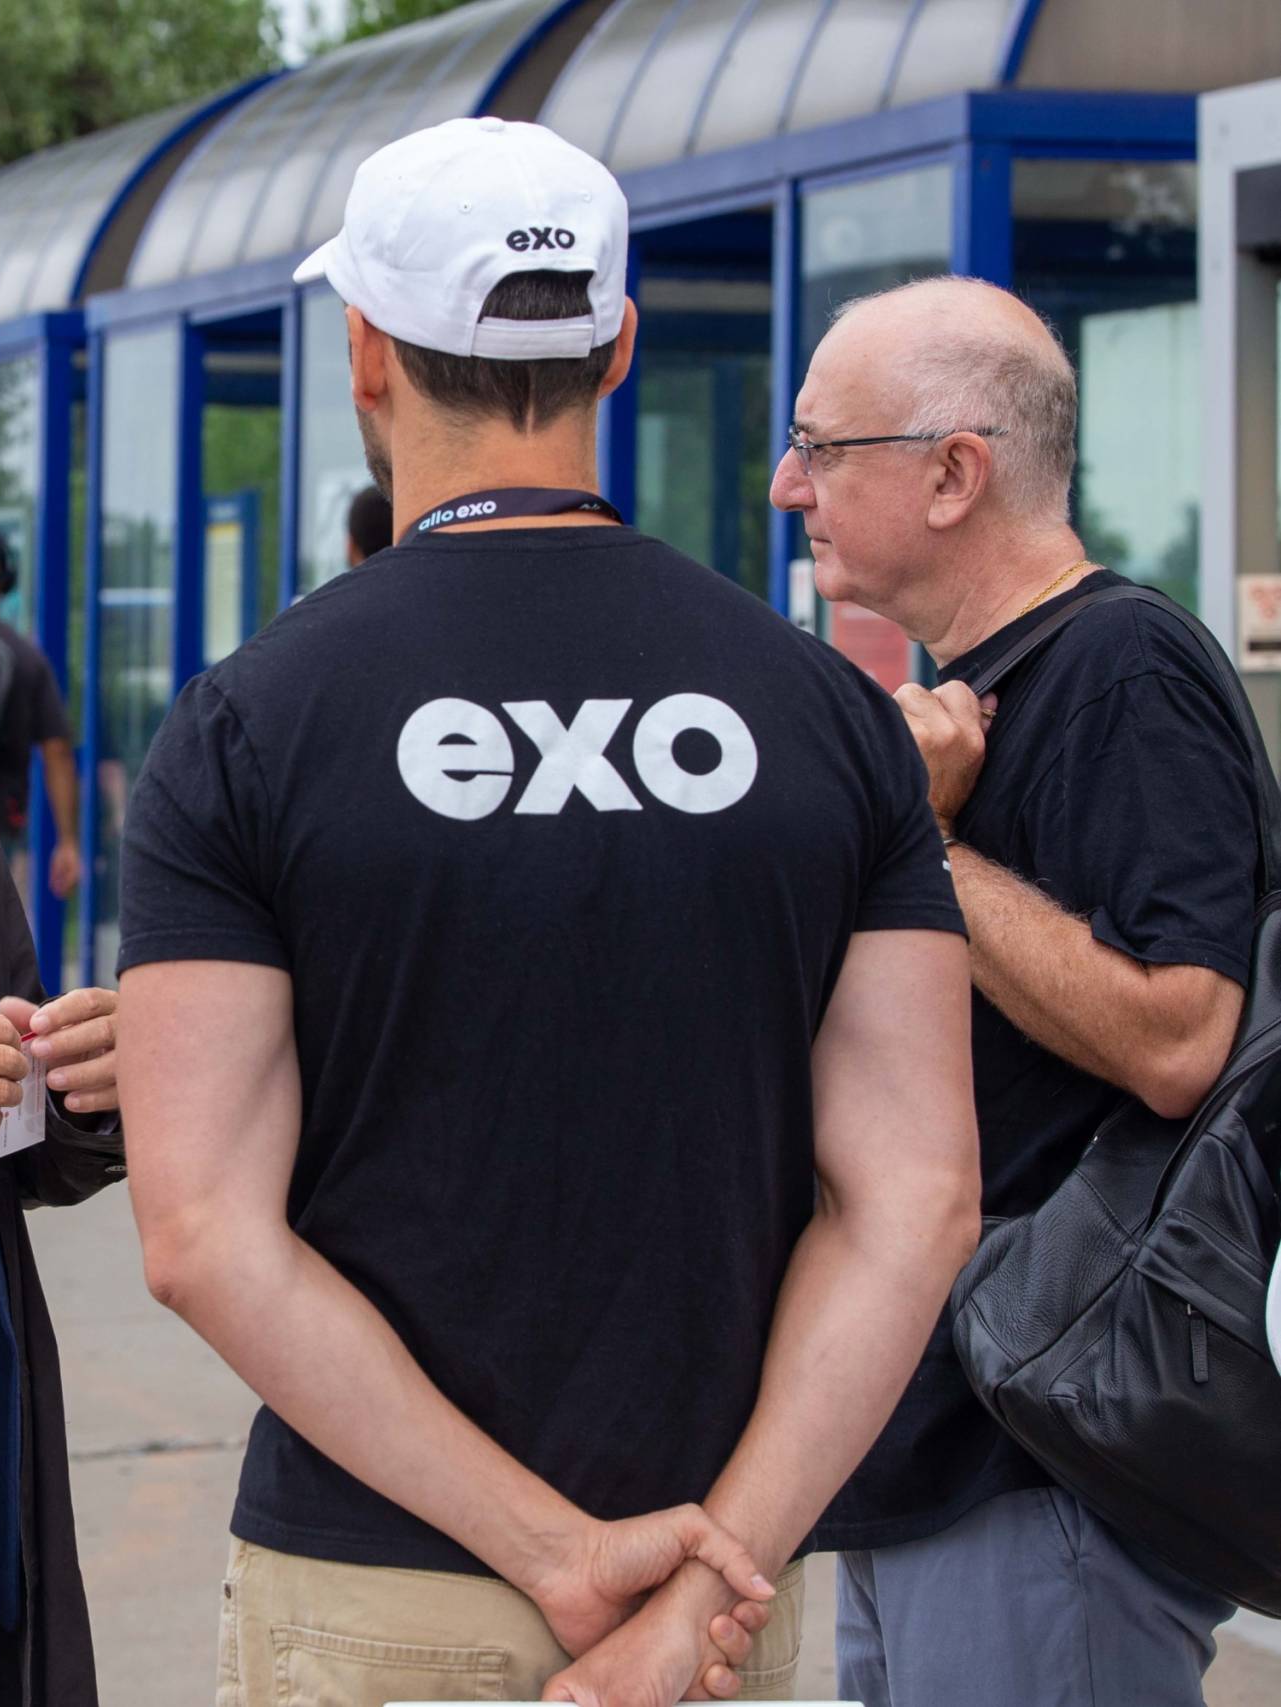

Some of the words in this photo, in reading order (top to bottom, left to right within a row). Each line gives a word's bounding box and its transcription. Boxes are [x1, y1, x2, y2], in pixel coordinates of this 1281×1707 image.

[506, 226, 576, 253] exo
[418, 509, 455, 531] allo
[456, 500, 497, 519] exo
[396, 692, 759, 822] exo
